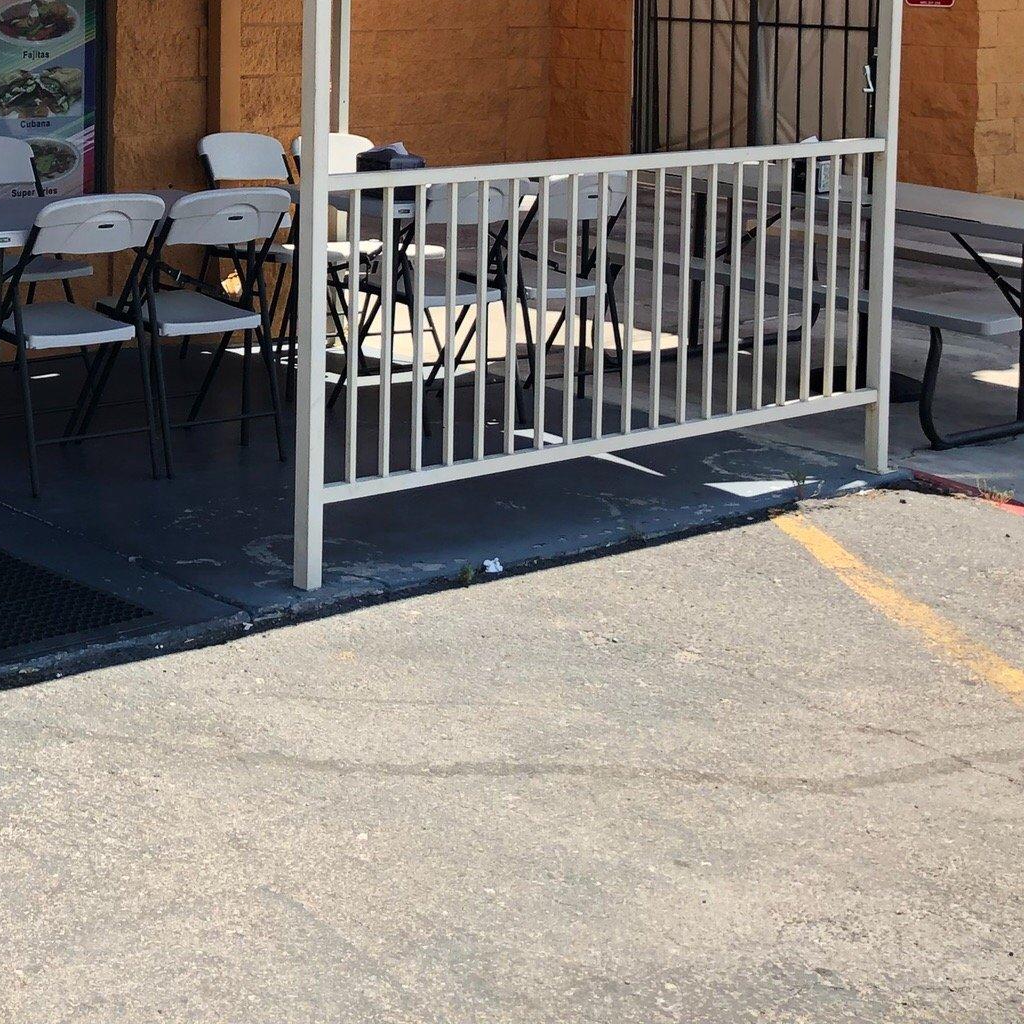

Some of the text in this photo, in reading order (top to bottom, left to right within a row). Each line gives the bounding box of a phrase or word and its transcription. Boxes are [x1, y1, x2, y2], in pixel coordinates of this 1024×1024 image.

[22, 50, 50, 60] Fajitas
[20, 119, 51, 129] Cubana
[11, 189, 36, 199] Super
